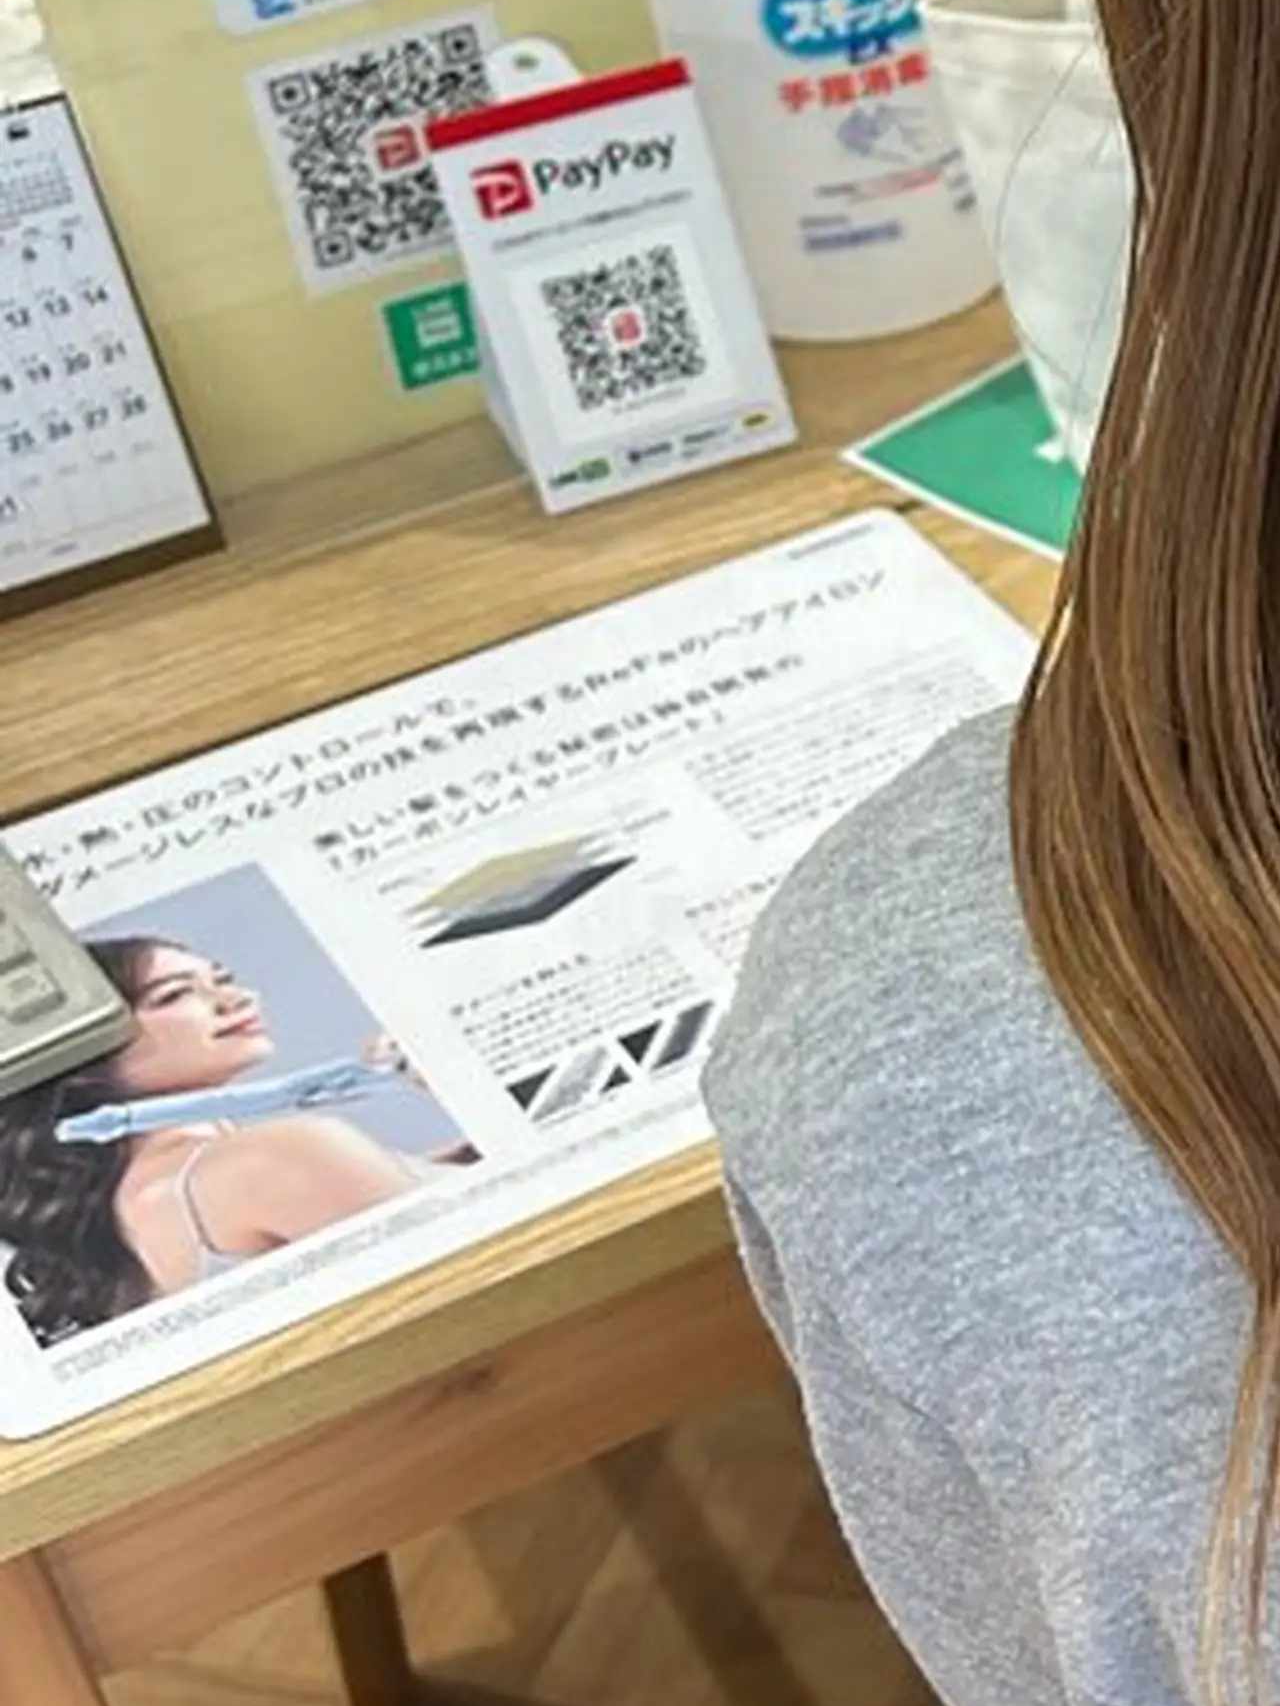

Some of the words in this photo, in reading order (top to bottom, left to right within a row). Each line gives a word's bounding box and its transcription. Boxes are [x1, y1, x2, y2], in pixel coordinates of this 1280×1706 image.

[532, 134, 677, 195] PayPay
[5, 308, 31, 329] 12
[43, 296, 72, 318] 13
[83, 285, 109, 309] 14
[25, 360, 52, 386] 19
[63, 351, 91, 378] 20
[102, 339, 128, 368] 21
[7, 430, 35, 456] 25
[46, 418, 73, 443] 26
[83, 406, 110, 432] 27
[120, 394, 147, 421] 28
